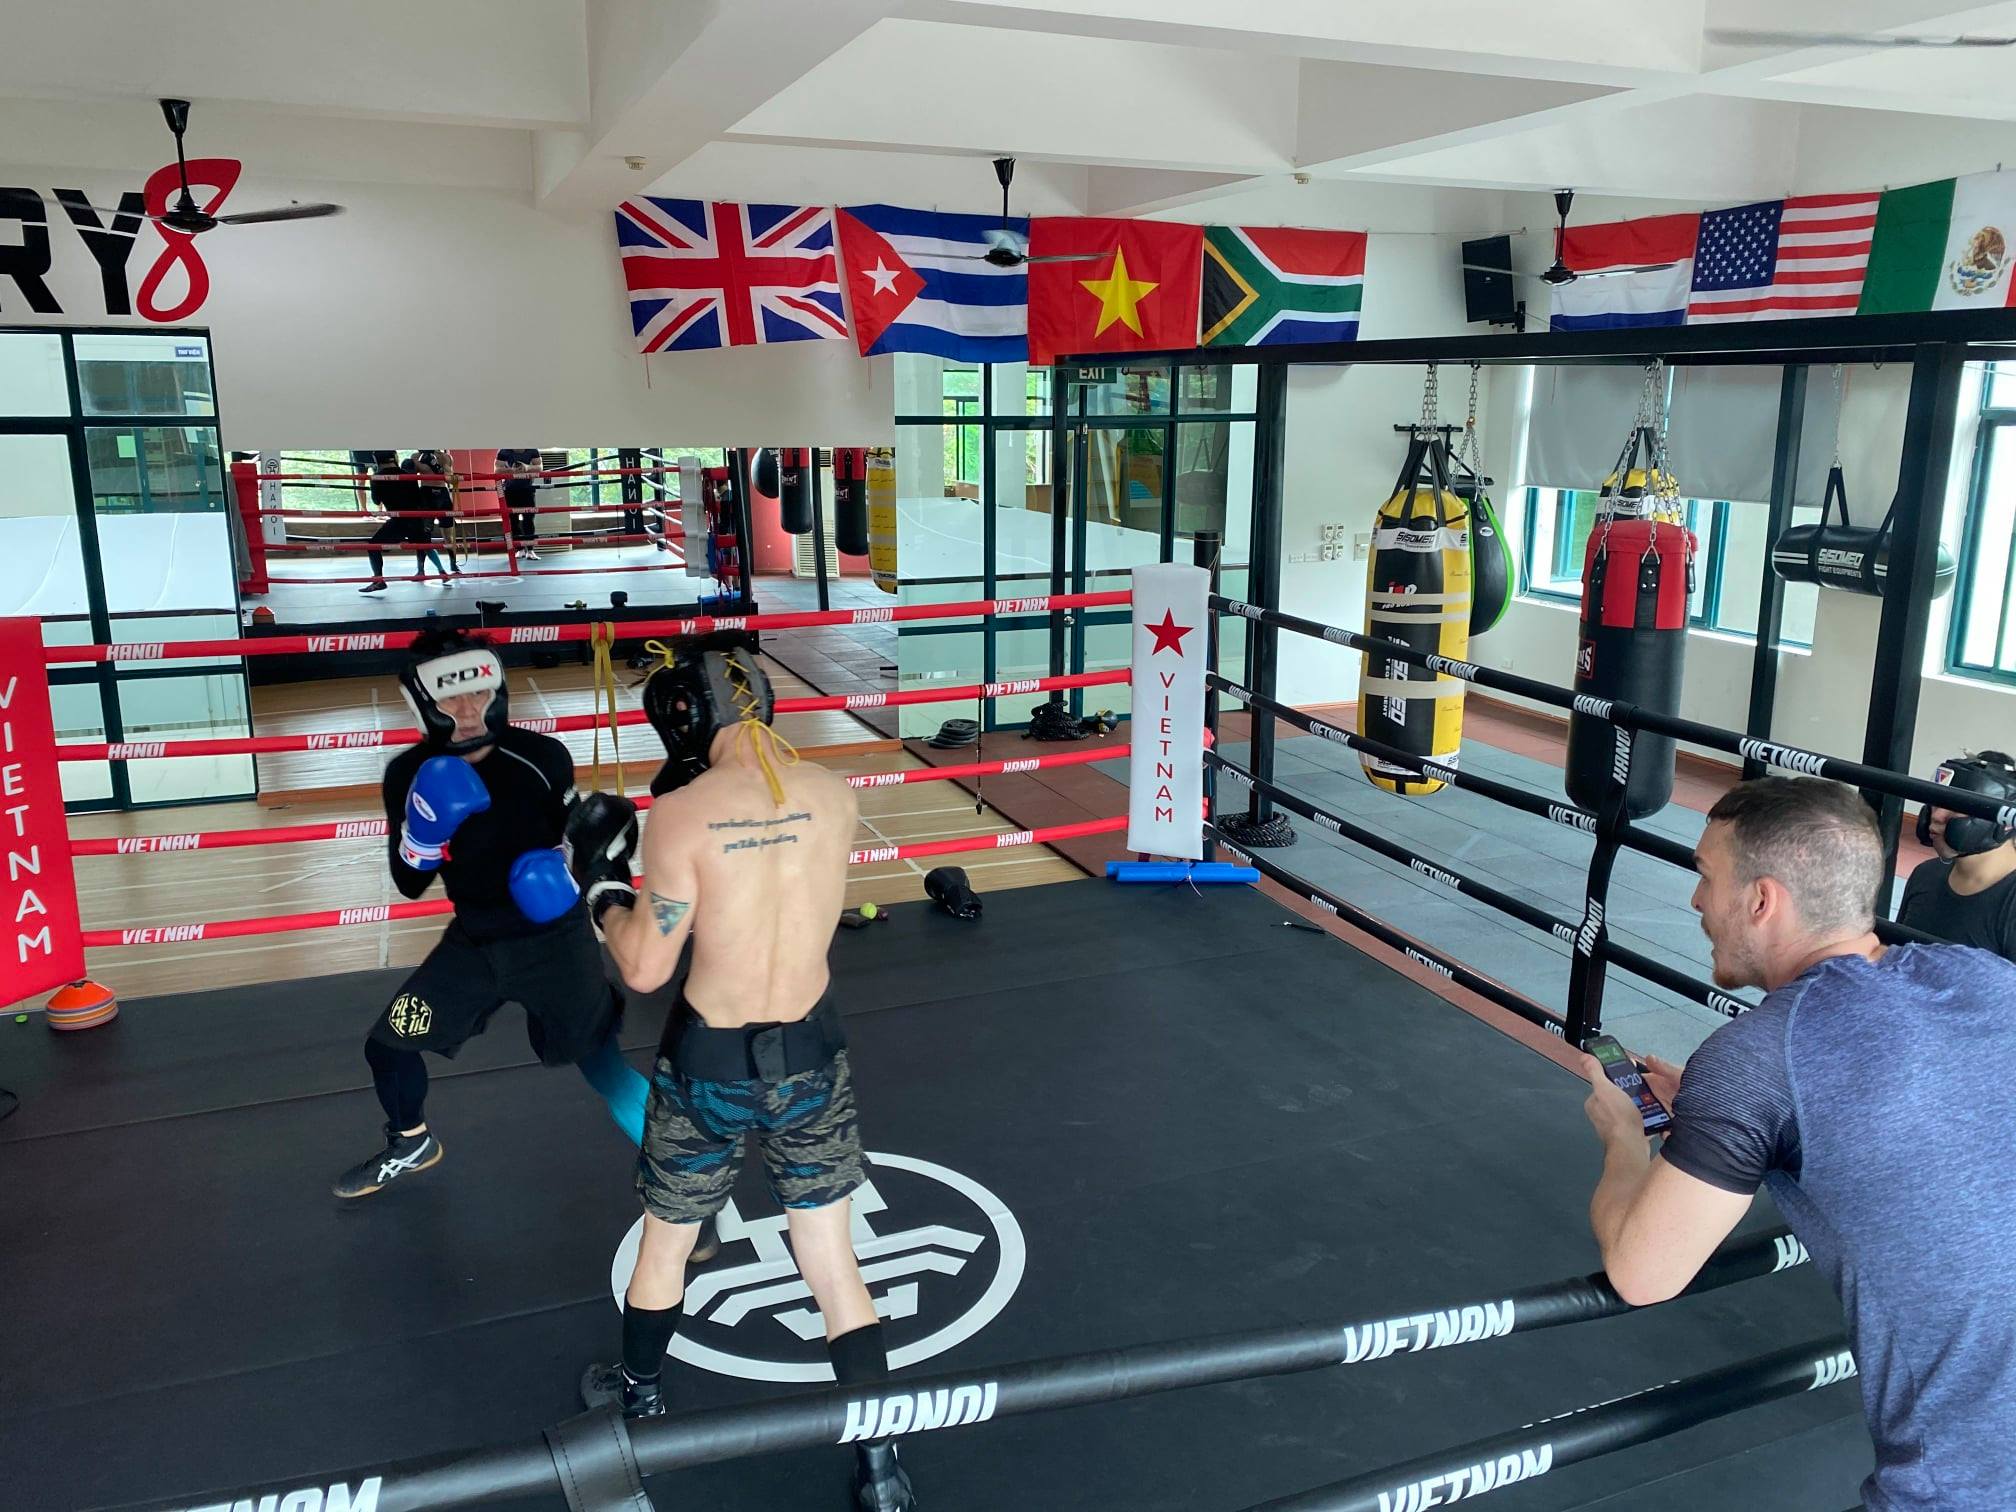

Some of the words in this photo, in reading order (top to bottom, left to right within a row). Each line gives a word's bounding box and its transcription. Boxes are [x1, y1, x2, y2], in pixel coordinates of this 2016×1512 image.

[1079, 367, 1105, 380] EXIT
[107, 643, 164, 661] HANOI
[308, 635, 385, 652] VIETNAM
[511, 626, 560, 642] HANOI
[682, 618, 746, 634] VINAM
[852, 607, 894, 623] HANOI
[993, 597, 1049, 615] VIETNAM
[437, 664, 493, 689] RDX
[108, 742, 166, 760] HANOI
[307, 731, 383, 748] VIETNAM
[846, 692, 887, 709] HANOI
[985, 678, 1040, 696] VIETNAM
[1228, 685, 1253, 701] HANOI
[1309, 720, 1351, 747] VIETNAM
[1422, 764, 1457, 786] HANOI
[1229, 600, 1265, 619] VIETNAM
[1323, 627, 1353, 644] HANOI
[1425, 654, 1479, 681] VIETNAM
[1738, 737, 1828, 777] VIETNAM
[1155, 672, 1175, 822] VIETNAM
[1613, 725, 1631, 785] HANOI
[0, 674, 52, 964] VIETNAM
[117, 833, 200, 854] VIETNAM
[336, 819, 386, 838] HANOI
[1002, 758, 1040, 774] HANOI
[1221, 765, 1255, 790] VIETNAM
[1313, 812, 1343, 833] HANOI
[1410, 858, 1461, 889] VIETNAM
[122, 923, 204, 945] VIETNAM
[339, 904, 390, 925] HANOI
[849, 846, 899, 865] IETNAM
[997, 829, 1034, 847] HANOI
[1219, 839, 1254, 865] VIETNAM
[1311, 894, 1338, 916] HANOI
[1405, 946, 1454, 979] VIETNAM
[1578, 897, 1603, 957] HANOI
[838, 1381, 1000, 1445] HANOI
[1341, 1299, 1517, 1365] VIETNAM
[1375, 1443, 1555, 1512] VIETNAM
